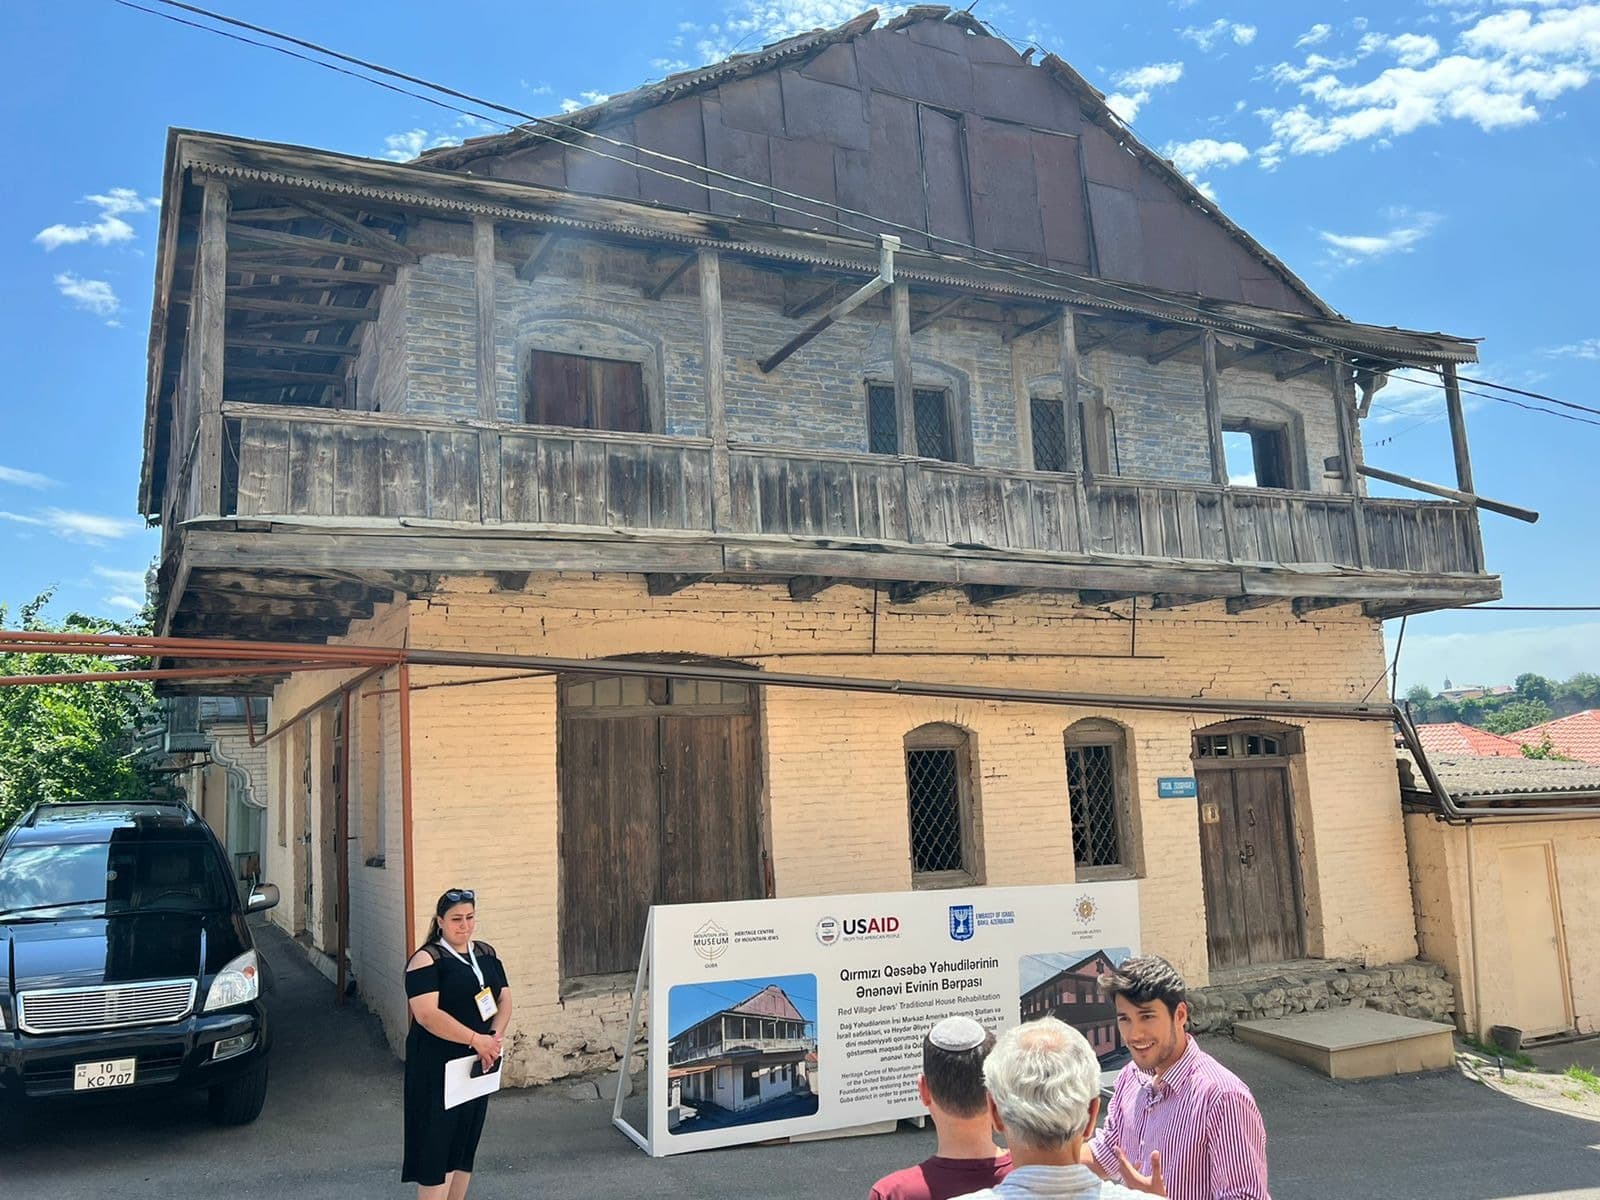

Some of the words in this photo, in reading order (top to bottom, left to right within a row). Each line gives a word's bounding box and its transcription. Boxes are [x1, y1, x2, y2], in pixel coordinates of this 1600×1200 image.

[843, 917, 900, 934] USAID
[694, 937, 729, 946] MUSEUM
[840, 969, 881, 981] Qırmızı
[884, 963, 927, 978] Qəsəbə
[929, 957, 999, 973] Yəhudilərinin
[856, 982, 902, 998] Ənənəvi
[906, 979, 938, 994] Evinin
[942, 977, 982, 991] Bərpası
[838, 1008, 852, 1016] Red
[854, 1006, 876, 1014] Village
[900, 1000, 934, 1009] Traditional
[957, 994, 1000, 1003] Rehabilitation
[100, 1063, 113, 1074] 10
[88, 1076, 105, 1088] KC
[109, 1073, 131, 1086] 707
